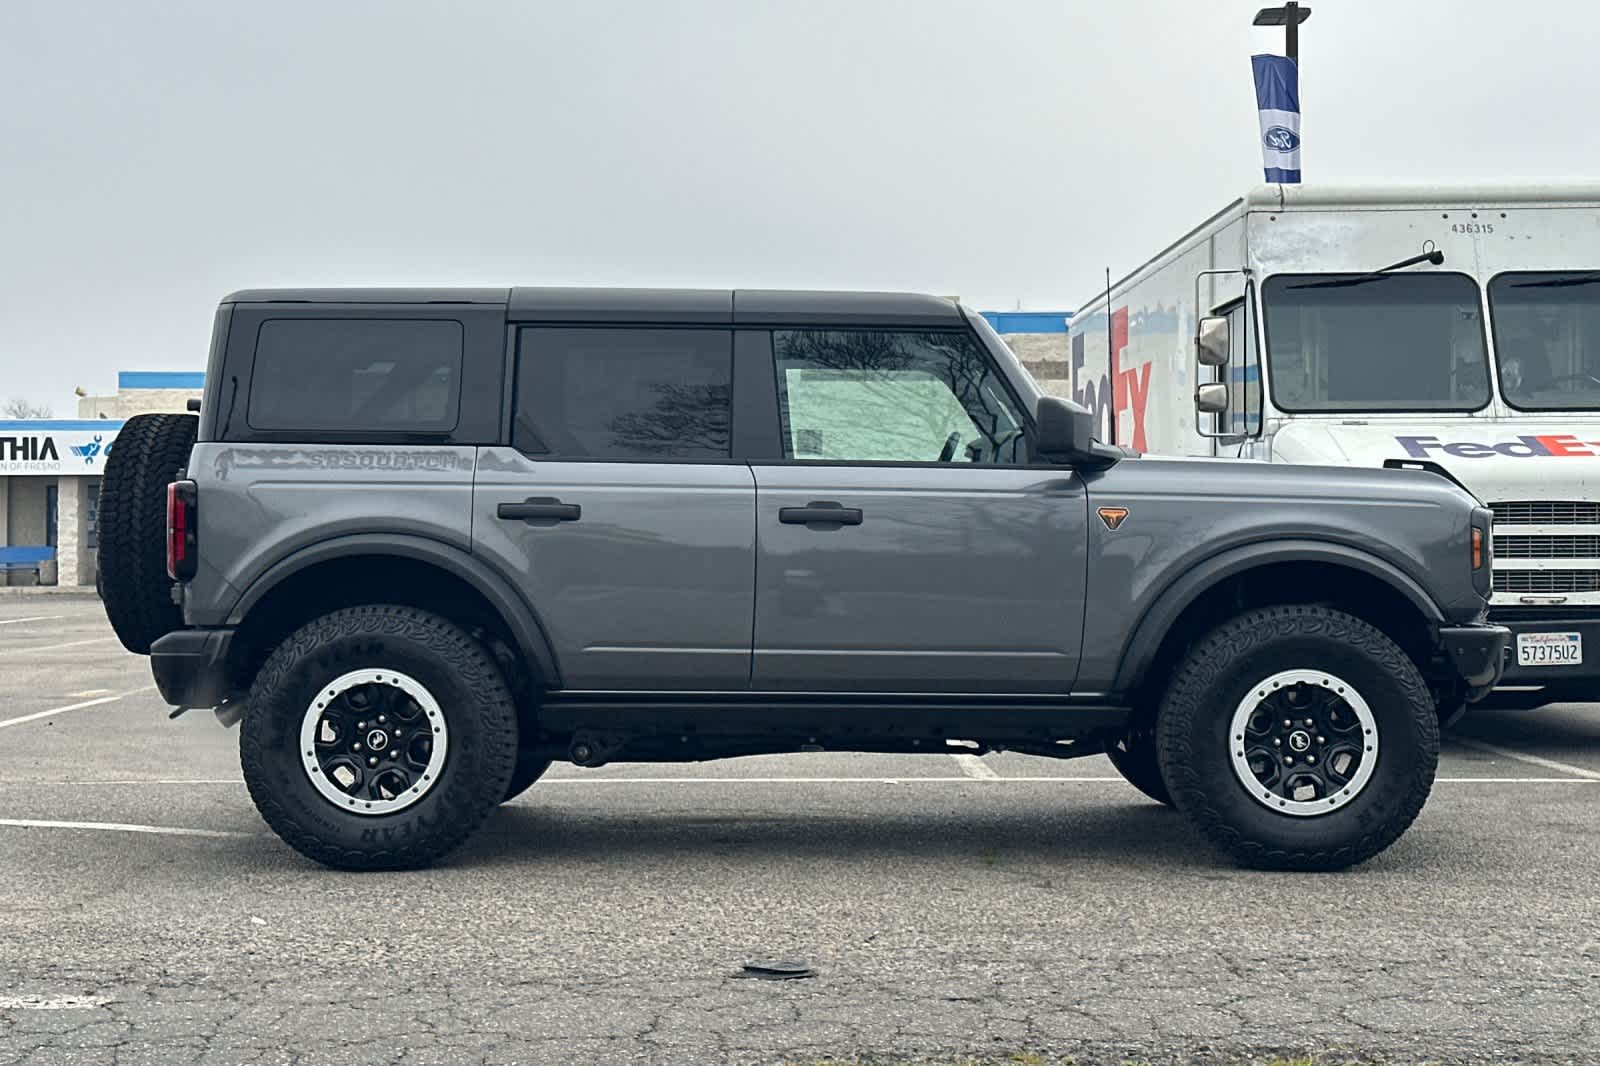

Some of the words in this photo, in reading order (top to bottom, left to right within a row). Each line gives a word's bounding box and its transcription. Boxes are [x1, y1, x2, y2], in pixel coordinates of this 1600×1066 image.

[1451, 223, 1494, 234] 436315
[1394, 435, 1600, 458] FedE
[10, 463, 21, 471] OF
[25, 463, 61, 471] FRESNO
[309, 453, 458, 469] SASQUATCH
[1522, 645, 1578, 661] 57375U2
